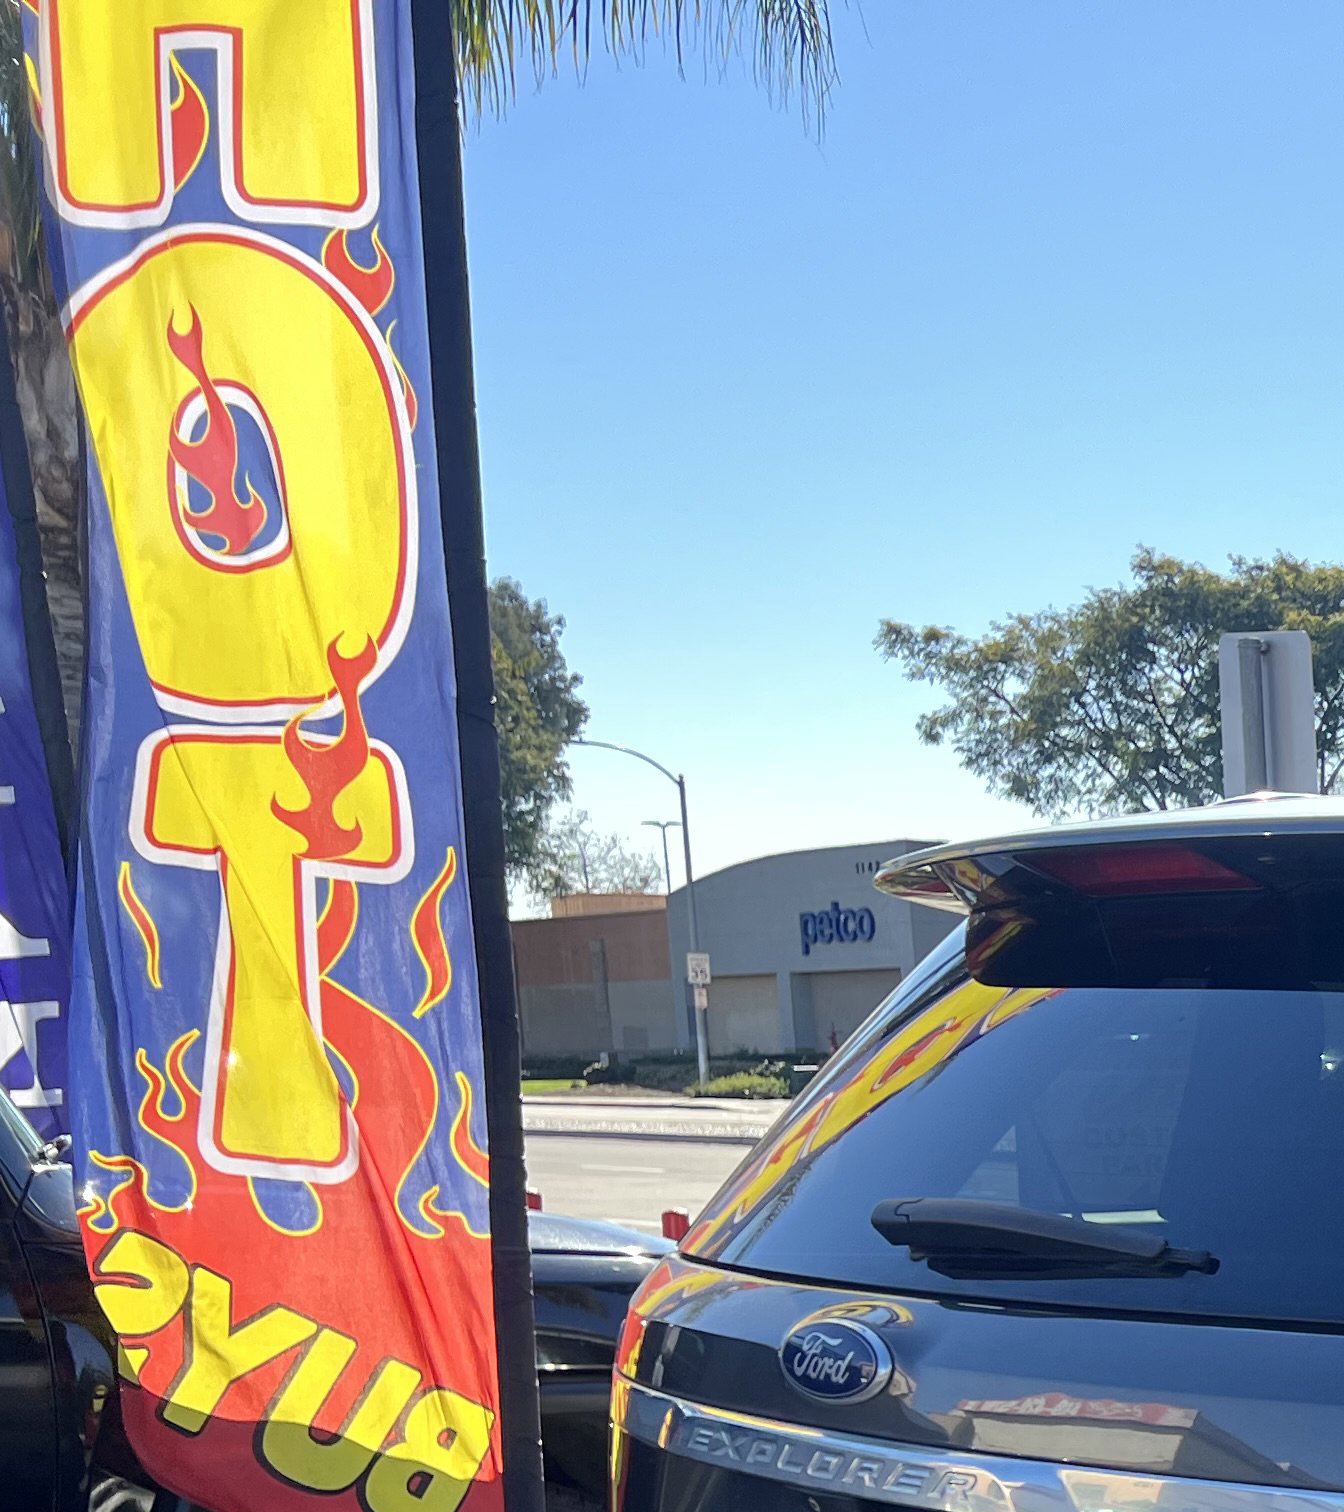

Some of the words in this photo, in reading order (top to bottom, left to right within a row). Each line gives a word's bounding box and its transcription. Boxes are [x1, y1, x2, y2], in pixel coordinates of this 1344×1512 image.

[800, 901, 875, 956] petco
[793, 1332, 855, 1384] Ford
[687, 1427, 977, 1502] EXPLORER
